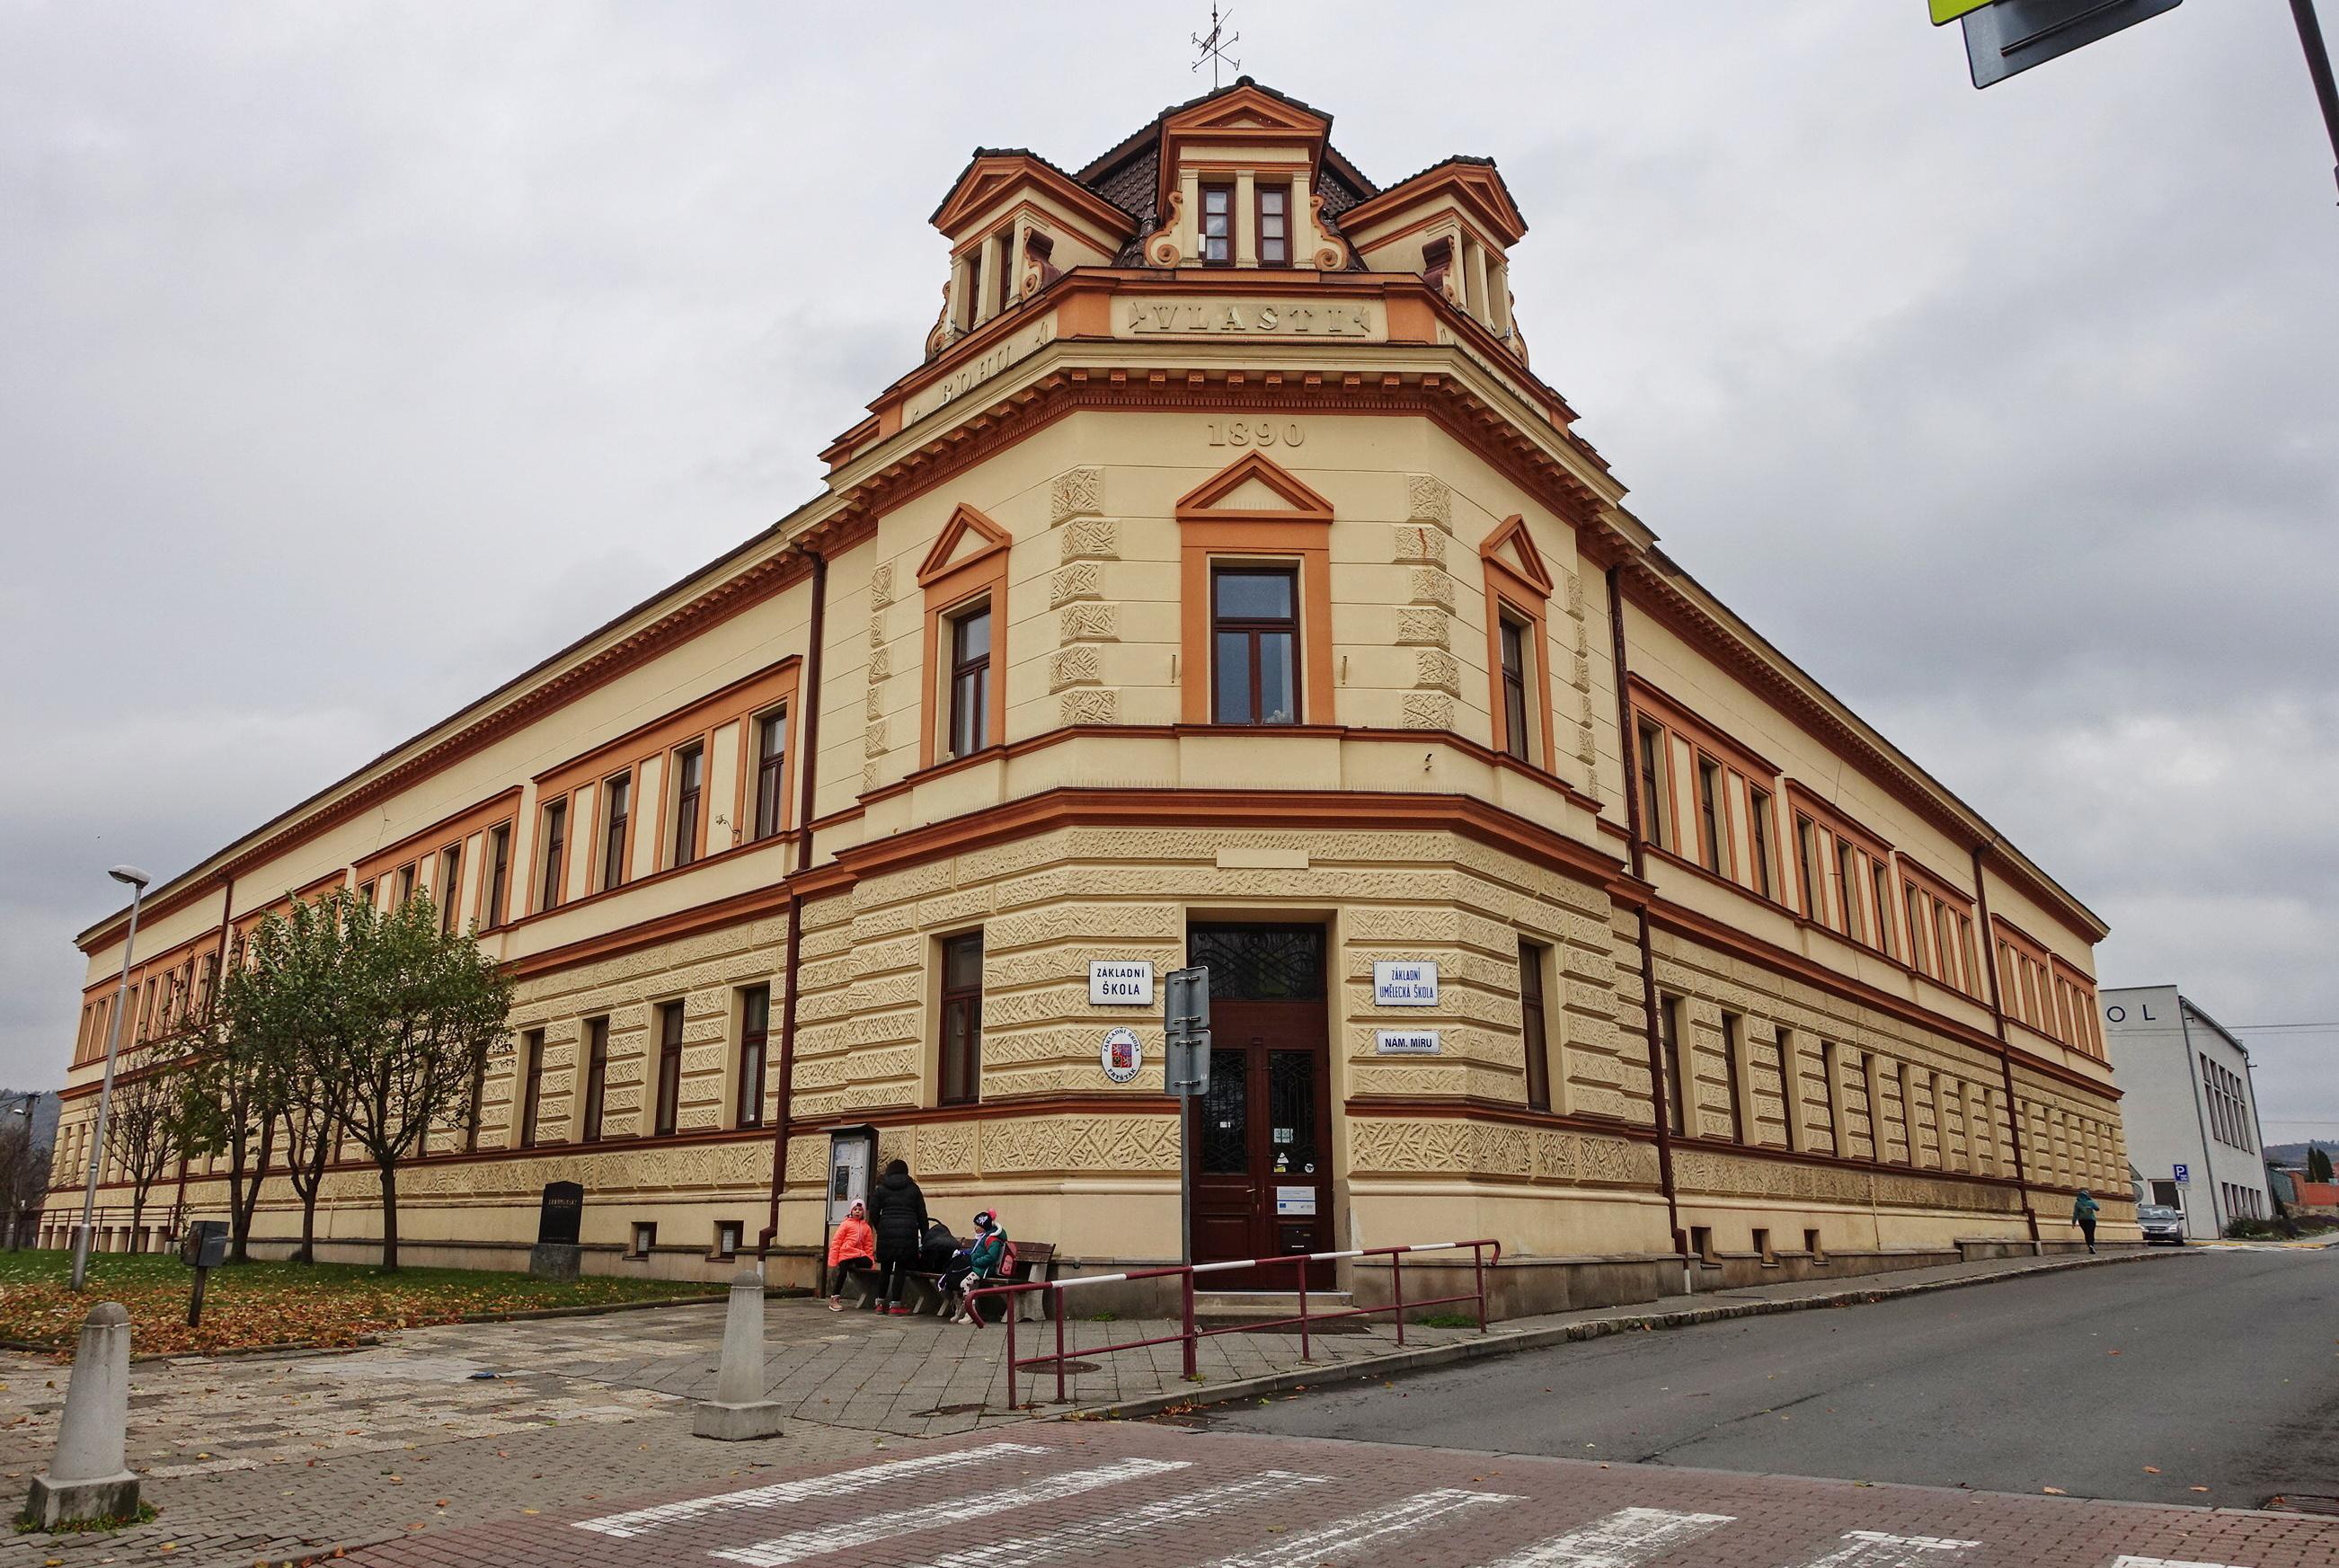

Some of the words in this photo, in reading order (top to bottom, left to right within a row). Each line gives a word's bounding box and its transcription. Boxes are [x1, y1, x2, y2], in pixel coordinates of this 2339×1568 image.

[1153, 306, 1343, 332] VLASTI
[1208, 422, 1306, 447] 1890
[1097, 966, 1145, 978] ZÁKLADNÍ
[1392, 967, 1421, 980] ZÁKLADNÍ
[1103, 980, 1140, 996] ŠKOLA
[1379, 984, 1411, 998] UMĚLECKÁ
[1413, 984, 1434, 998] ŠKOLA
[1385, 1036, 1408, 1048] NÁM.
[1410, 1036, 1432, 1048] MÍRU
[2175, 1166, 2185, 1177] P
